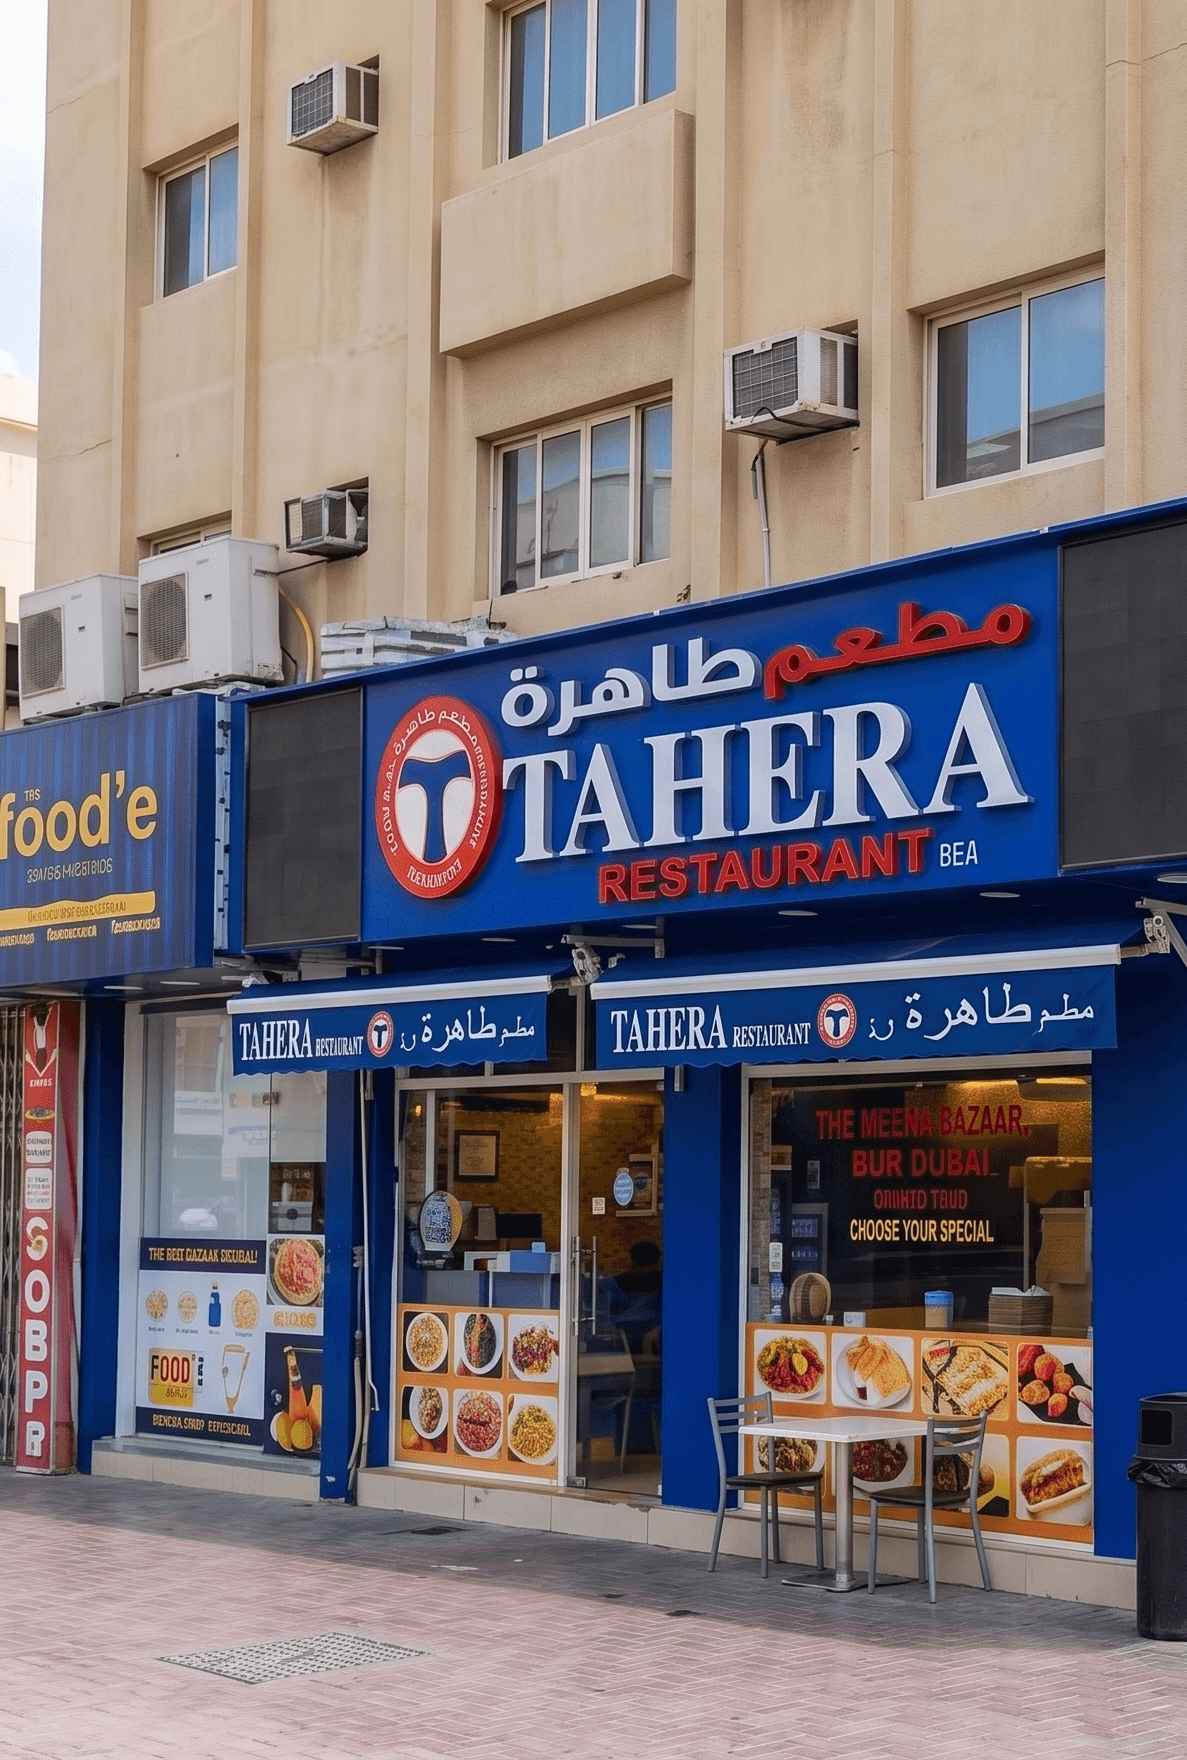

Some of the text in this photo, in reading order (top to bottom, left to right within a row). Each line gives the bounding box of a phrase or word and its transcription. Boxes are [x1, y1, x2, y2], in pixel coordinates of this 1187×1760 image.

[500, 601, 1032, 737] مطعم طاهرة
[502, 682, 1035, 863] TAHERA
[598, 827, 979, 904] RESTAURANT BEA
[421, 1005, 497, 1052] طاهرة
[610, 1003, 811, 1053] TAHERA RESTAURANT
[905, 982, 1032, 1041] طاهرة
[239, 1018, 314, 1061] TAHERA
[315, 1036, 363, 1057] RESTAURANT
[815, 1109, 855, 1139] THE
[861, 1107, 934, 1138] MEENA
[852, 1148, 990, 1177] BUR DUBAI
[148, 1247, 165, 1261] THE
[850, 1219, 994, 1242] CHOOSE YOUR SPECIAL
